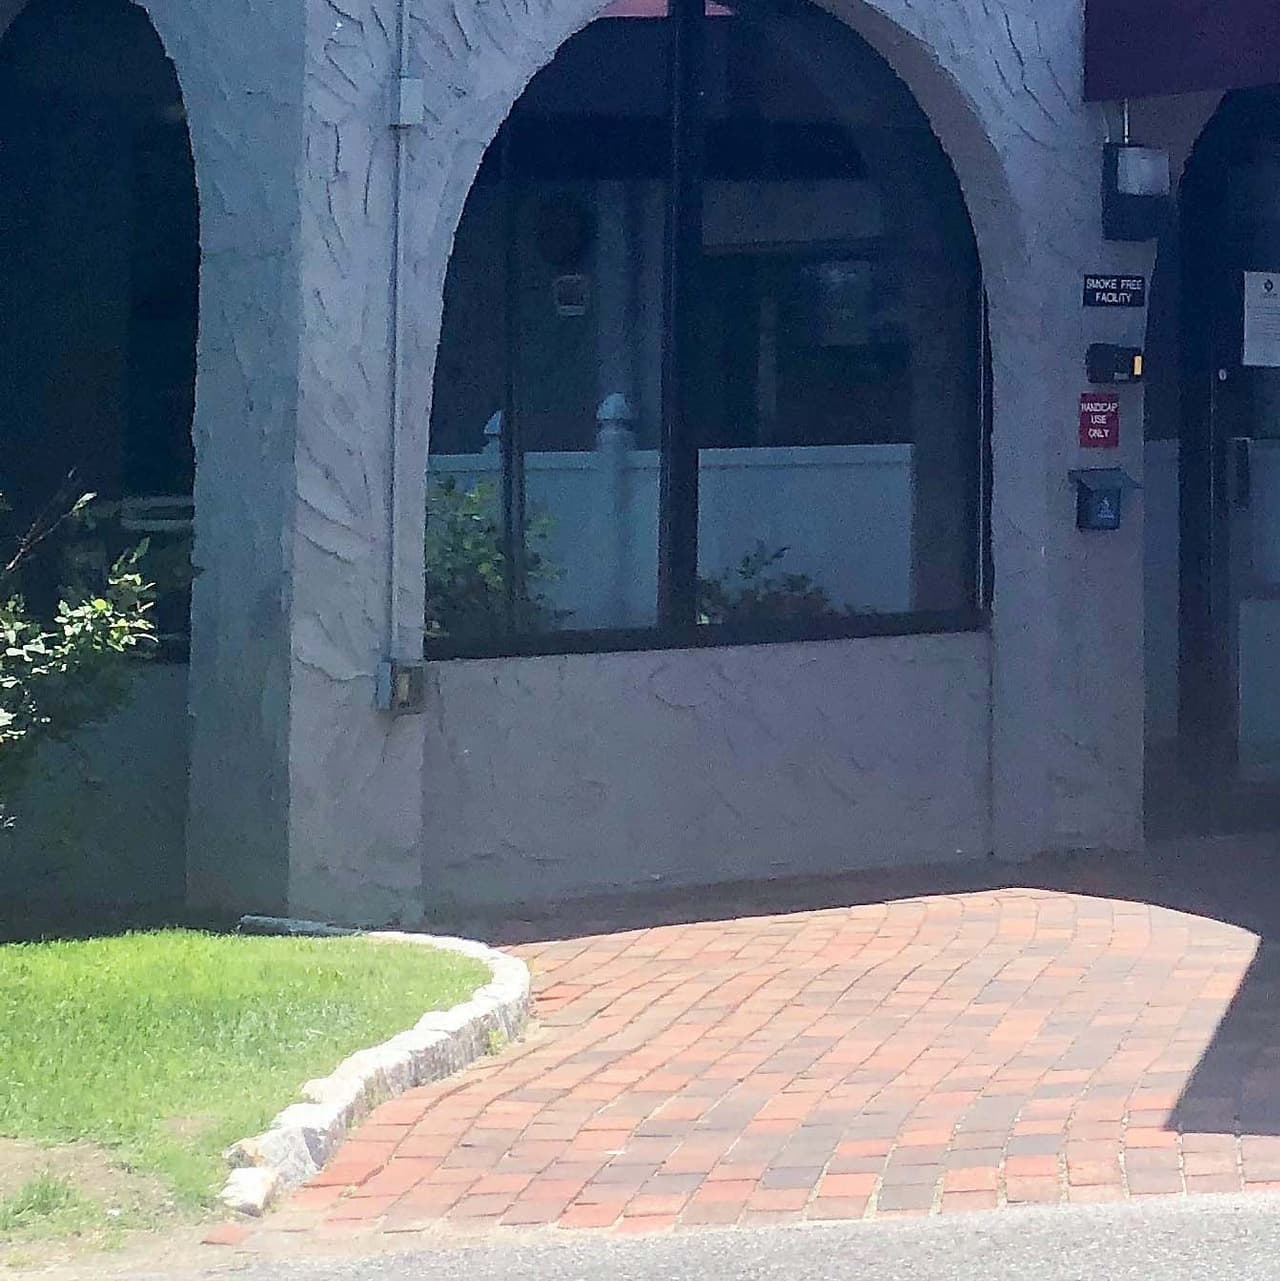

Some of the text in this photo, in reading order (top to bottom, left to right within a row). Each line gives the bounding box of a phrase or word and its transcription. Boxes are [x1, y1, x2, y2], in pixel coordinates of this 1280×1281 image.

[1086, 278, 1142, 290] SMOKE FREE
[1095, 292, 1131, 303] FACILITY
[1081, 402, 1118, 412] HANDICAP
[1091, 414, 1107, 424] USE
[1088, 428, 1110, 438] ONLY
